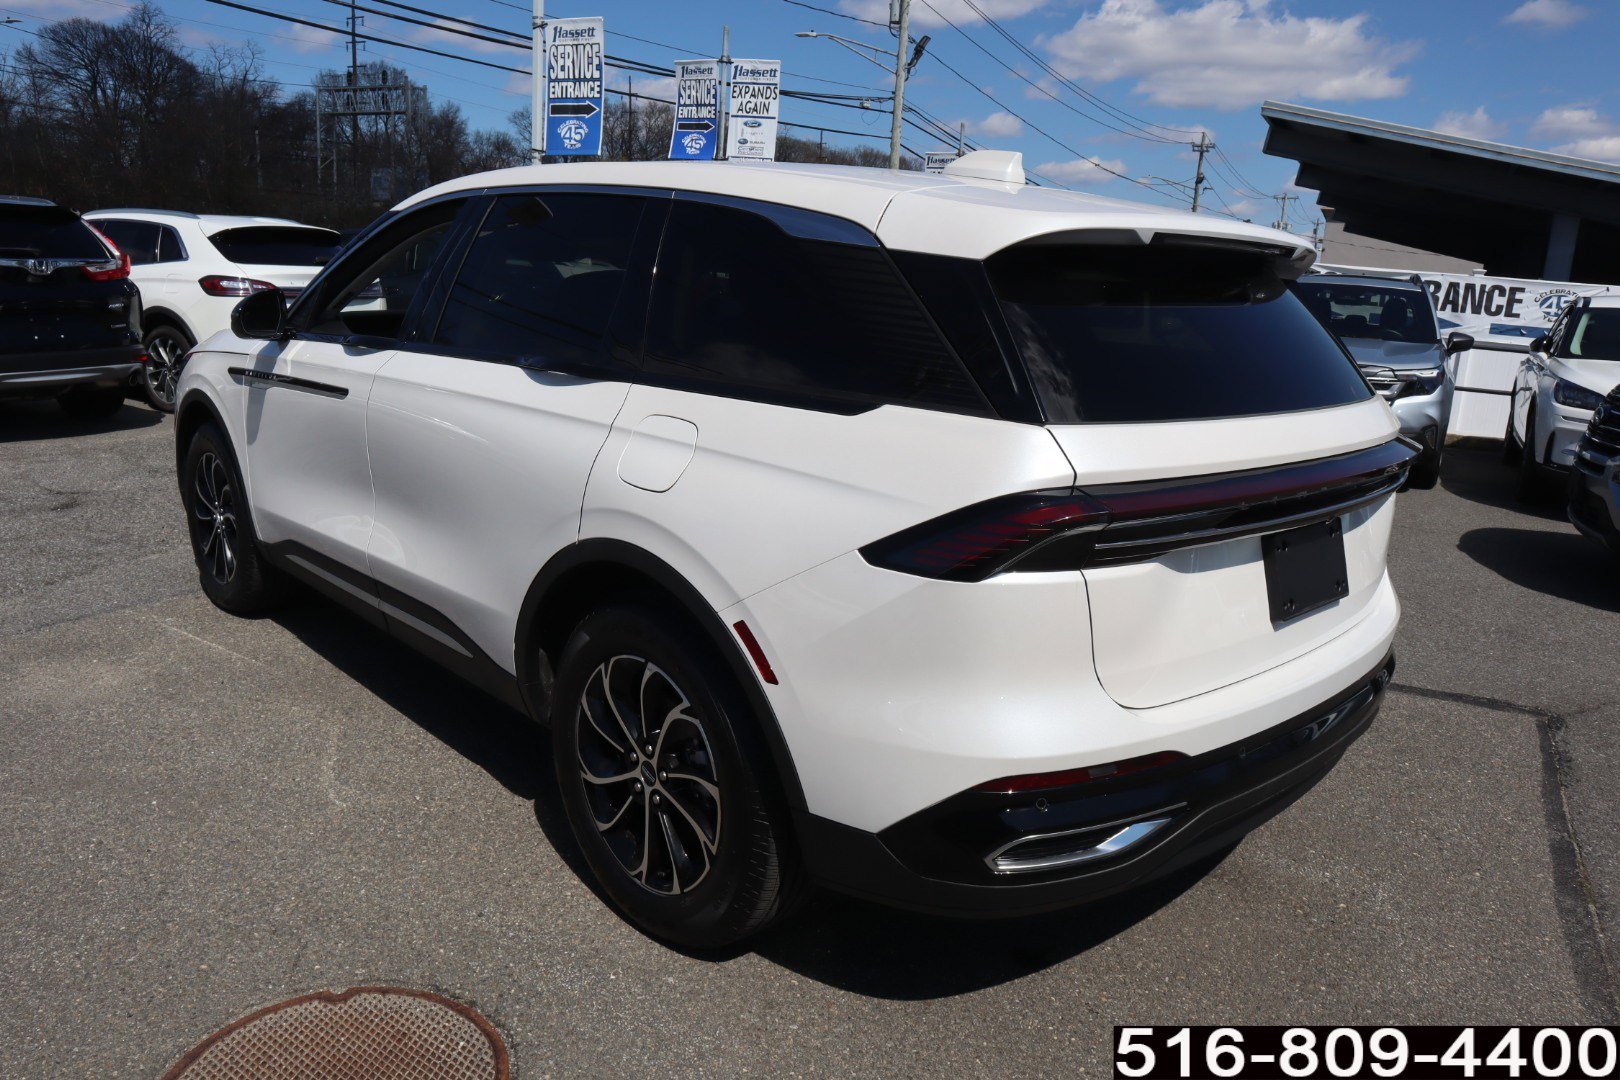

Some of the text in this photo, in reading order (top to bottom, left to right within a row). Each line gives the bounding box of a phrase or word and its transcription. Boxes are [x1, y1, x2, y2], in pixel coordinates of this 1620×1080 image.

[552, 26, 596, 42] Hassett
[549, 43, 601, 79] SERVICE
[681, 65, 713, 78] Hassett
[732, 64, 778, 79] Hassett
[549, 81, 601, 98] ENTRANCE
[680, 78, 716, 105] SERVICE
[731, 85, 778, 100] EXPANDS
[678, 106, 716, 118] ENTRANCE
[737, 100, 770, 115] AGAIN
